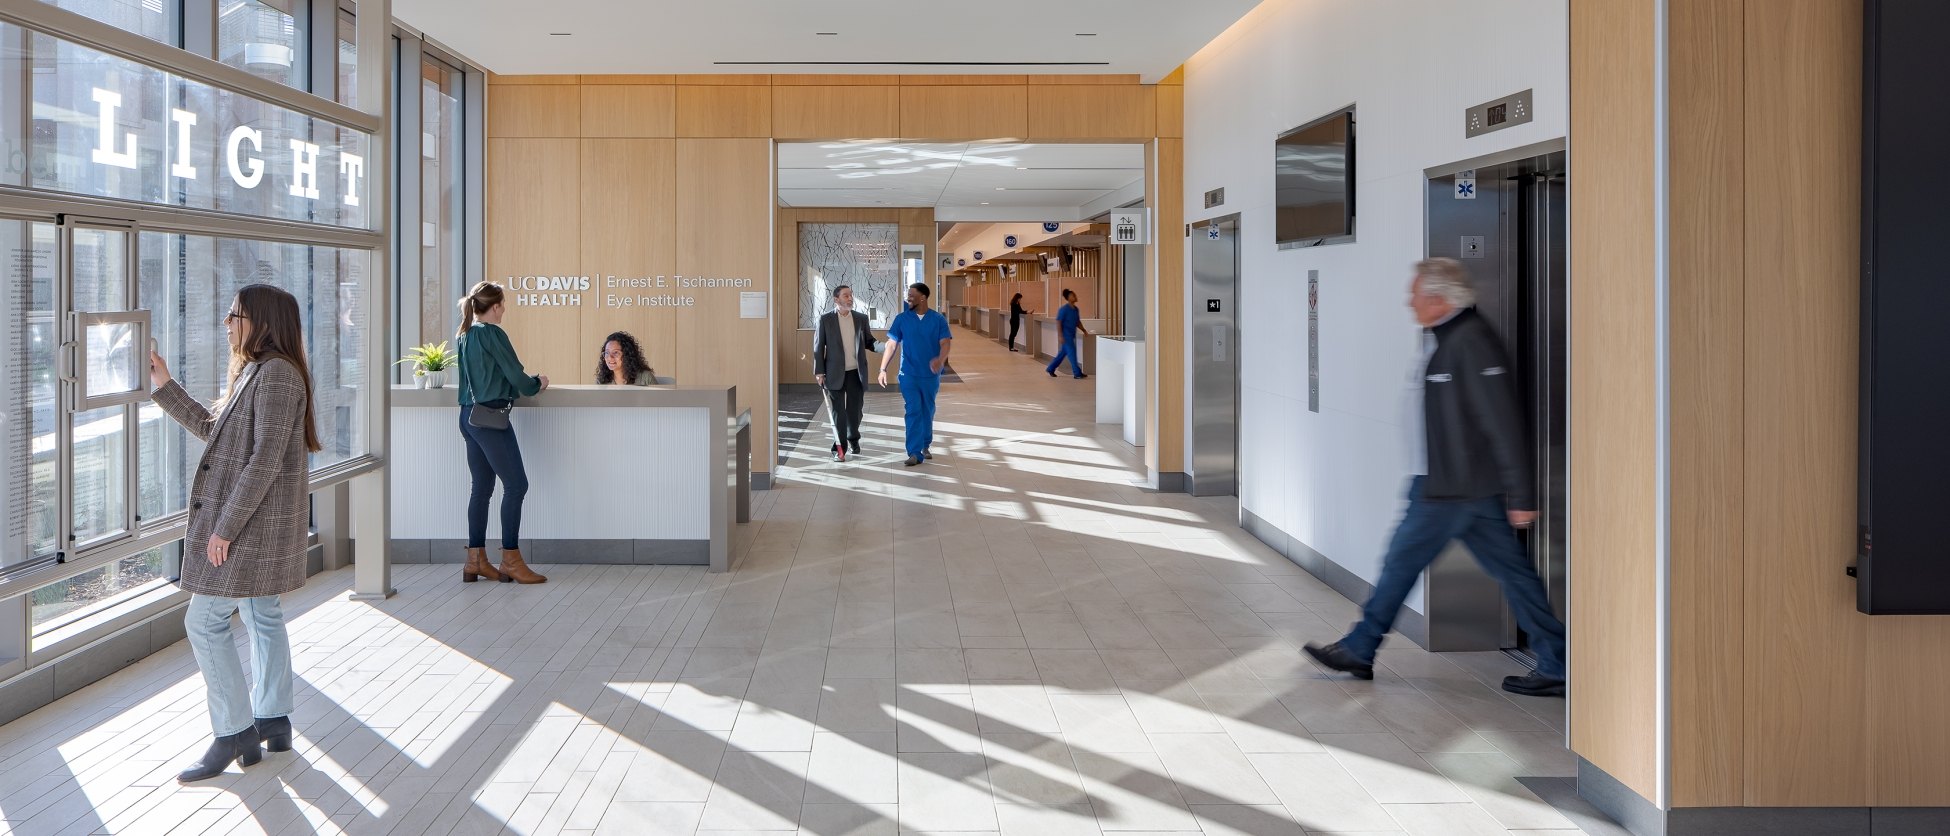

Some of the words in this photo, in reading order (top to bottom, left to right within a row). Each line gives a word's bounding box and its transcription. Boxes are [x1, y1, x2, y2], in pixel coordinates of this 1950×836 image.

[92, 87, 363, 207] LIGHT
[607, 275, 652, 288] Ernest
[656, 275, 669, 288] E.
[674, 275, 752, 288] Tschannen
[517, 293, 581, 306] HEALTH
[607, 294, 633, 309] Eye
[637, 294, 695, 307] Institute
